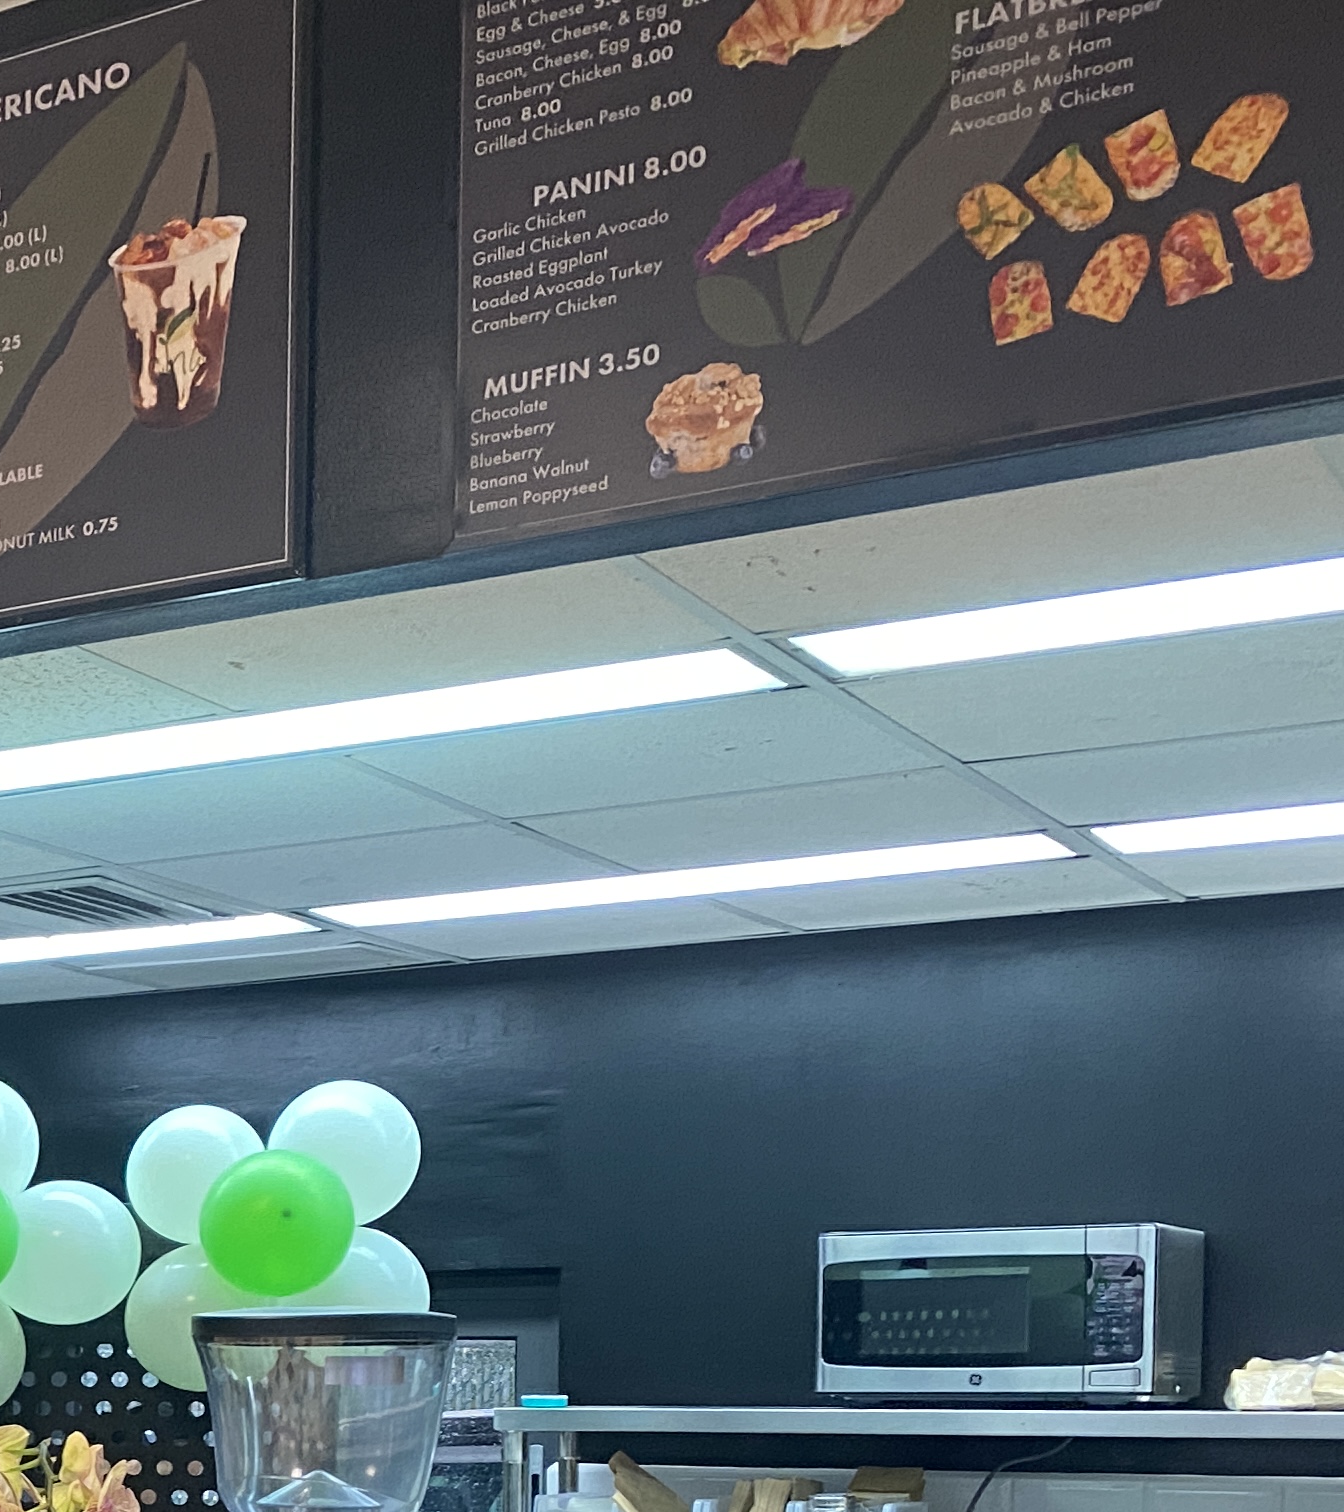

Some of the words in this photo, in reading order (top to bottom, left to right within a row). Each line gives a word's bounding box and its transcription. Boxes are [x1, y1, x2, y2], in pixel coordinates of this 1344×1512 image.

[473, 128, 527, 156] Grilled
[531, 117, 594, 142] Chicken
[598, 105, 641, 125] Pesto
[649, 86, 693, 112] 8.00
[474, 115, 512, 133] Tuna
[520, 97, 562, 122] 8.00
[948, 102, 1033, 136] Avocado
[1038, 96, 1053, 115] &
[1058, 81, 1135, 109] Chicken
[533, 162, 635, 207] PANINI
[643, 144, 707, 180] 8.00
[472, 221, 520, 244] Garlic
[524, 208, 587, 232] Chicken
[472, 240, 525, 267] Grilled
[529, 229, 591, 254] Chicken
[595, 208, 669, 239] Avocado
[471, 284, 529, 313] Loaded
[532, 270, 605, 299] Avocado
[608, 259, 663, 282] Turkey
[472, 261, 534, 289] Roasted
[538, 246, 608, 277] Eggplant
[483, 356, 590, 400] MUFFIN
[598, 343, 660, 376] 3.50
[470, 399, 548, 424] Chocolate
[469, 421, 556, 447] Strawberry
[469, 446, 544, 470] Blueberry
[469, 472, 528, 492] Banana
[532, 457, 590, 480] Walnut
[468, 496, 518, 515] Lemon
[522, 474, 609, 505] Poppyseed
[38, 523, 75, 545] MILK
[82, 515, 119, 537] 0.75
